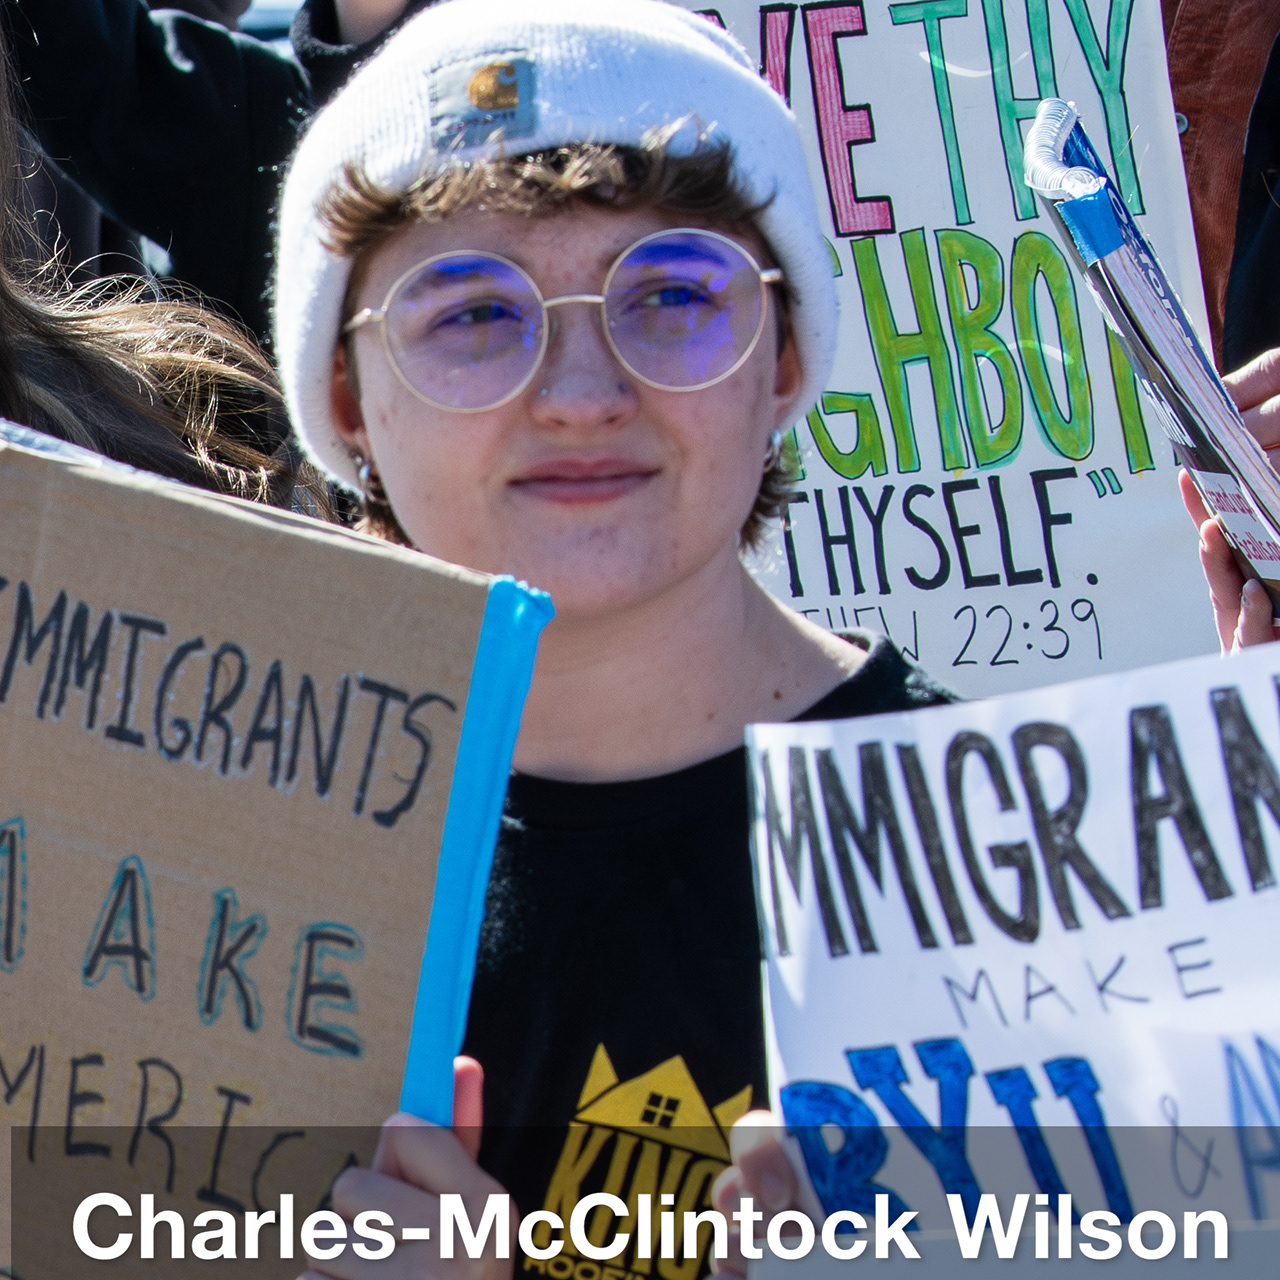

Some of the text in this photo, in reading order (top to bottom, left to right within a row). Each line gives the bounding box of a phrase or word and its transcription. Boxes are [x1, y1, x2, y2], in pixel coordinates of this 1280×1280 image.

[888, 0, 1146, 226] THY
[952, 598, 1103, 667] 22:39
[941, 937, 1225, 1030] MAKE
[1159, 1094, 1222, 1200] &
